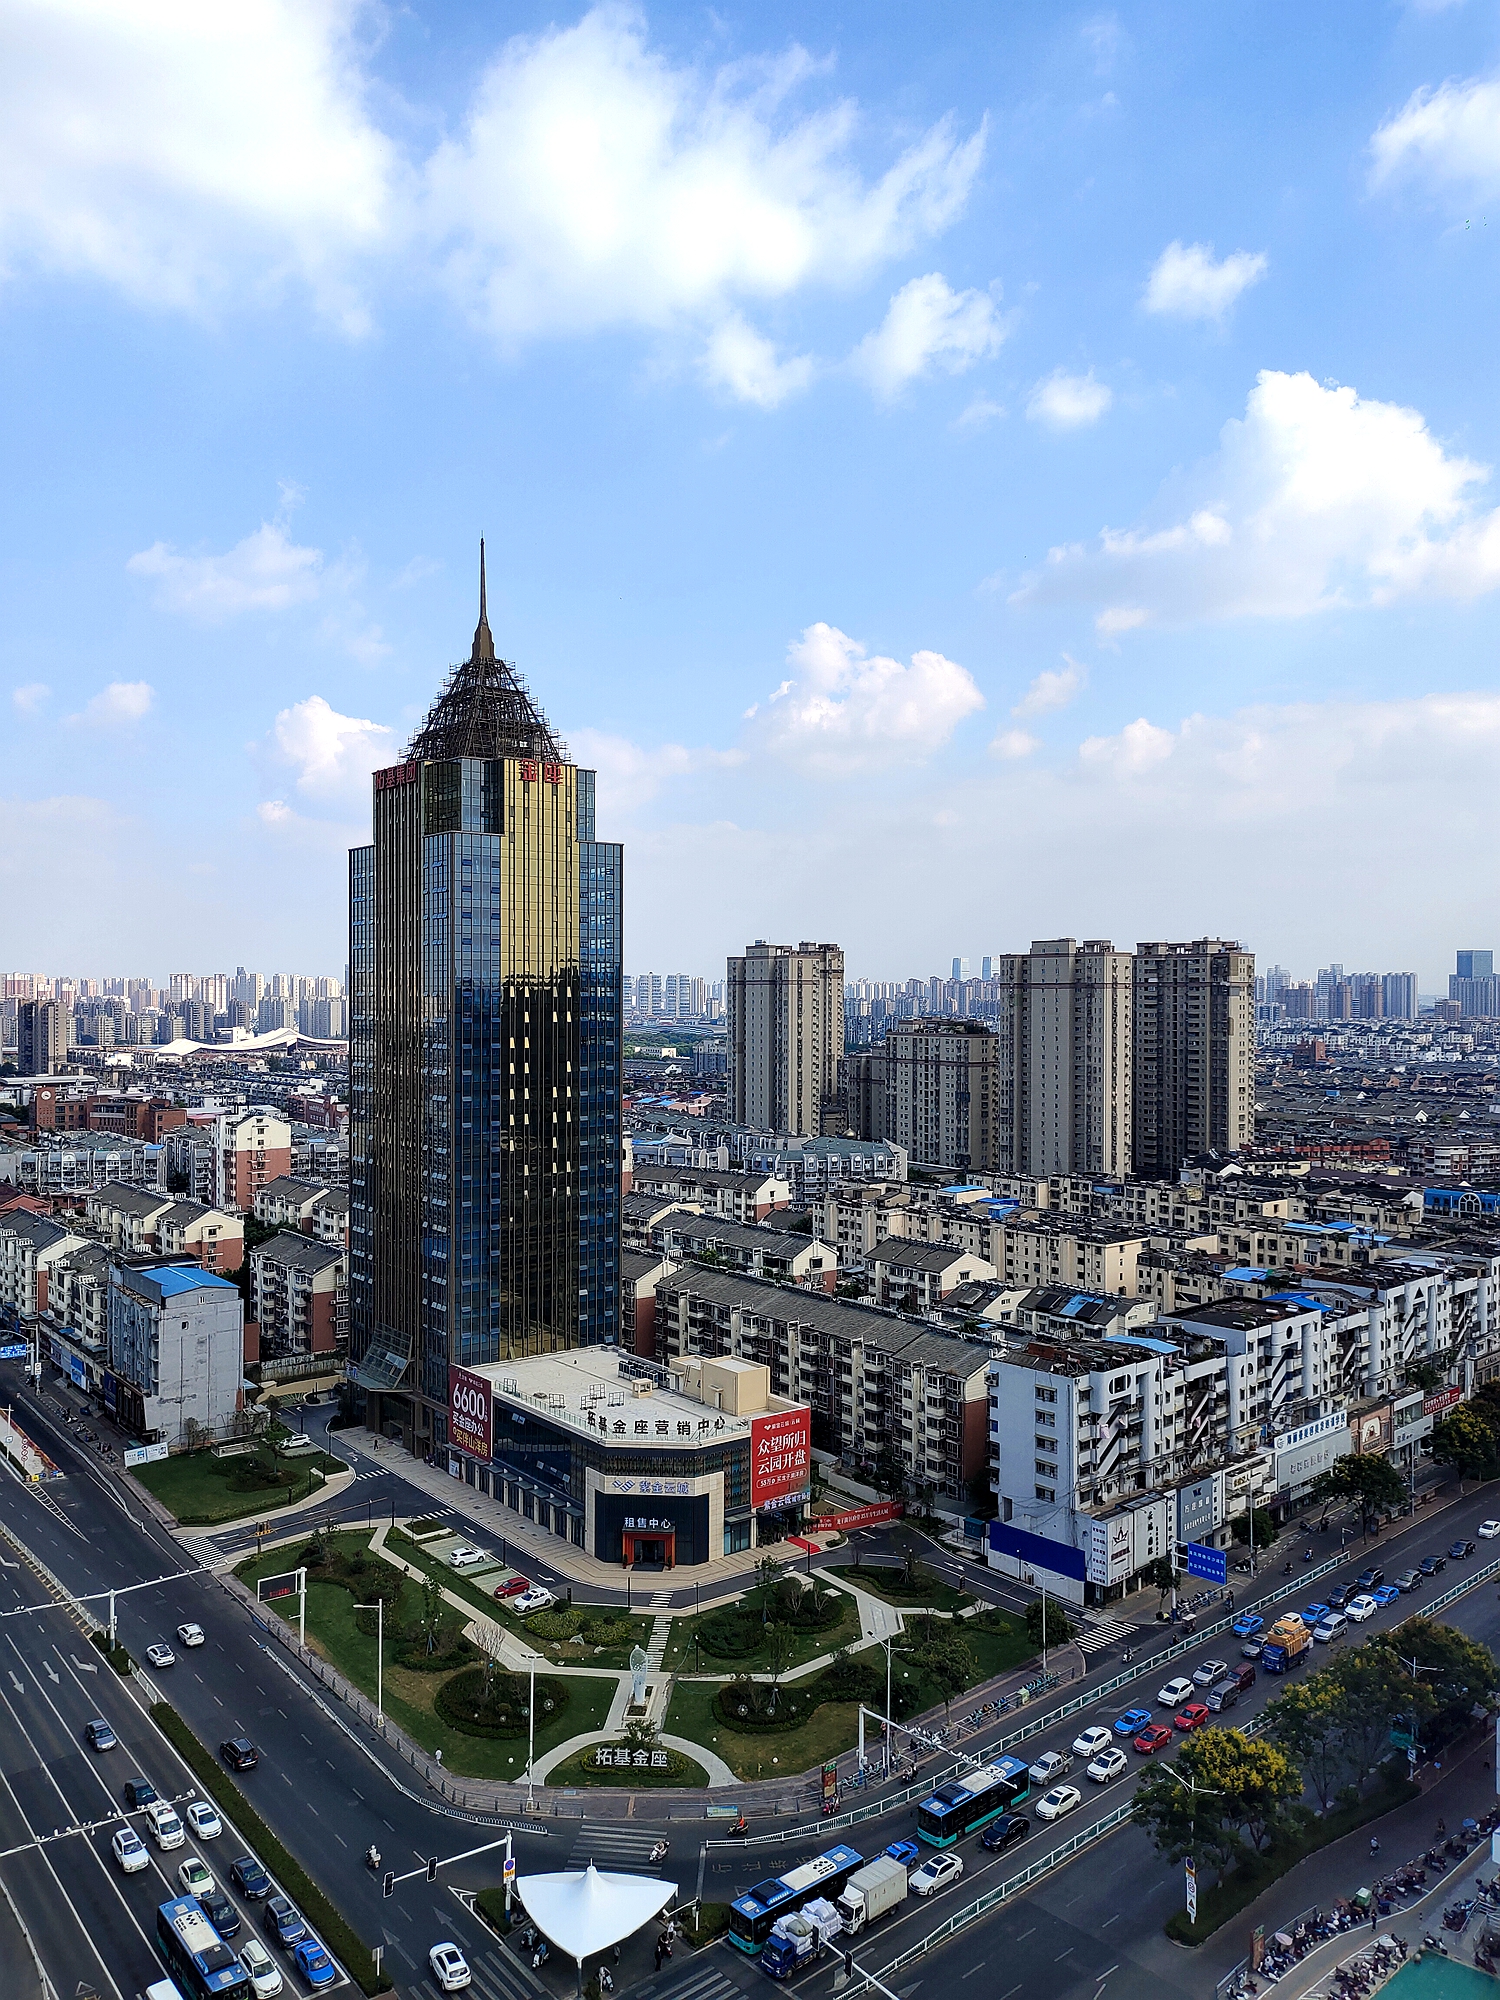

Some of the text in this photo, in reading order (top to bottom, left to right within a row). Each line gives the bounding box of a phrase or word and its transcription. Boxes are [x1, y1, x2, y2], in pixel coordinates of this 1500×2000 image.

[375, 760, 416, 790] 拓基集团
[453, 1383, 485, 1421] 6600
[587, 1410, 725, 1436] 拓基金座营销中心
[757, 1430, 806, 1456] 众望所归
[757, 1449, 806, 1475] 云园开盘
[639, 1481, 690, 1494] 紫金云城
[624, 1517, 671, 1529] 租售中心
[596, 1747, 668, 1767] 拓基金座
